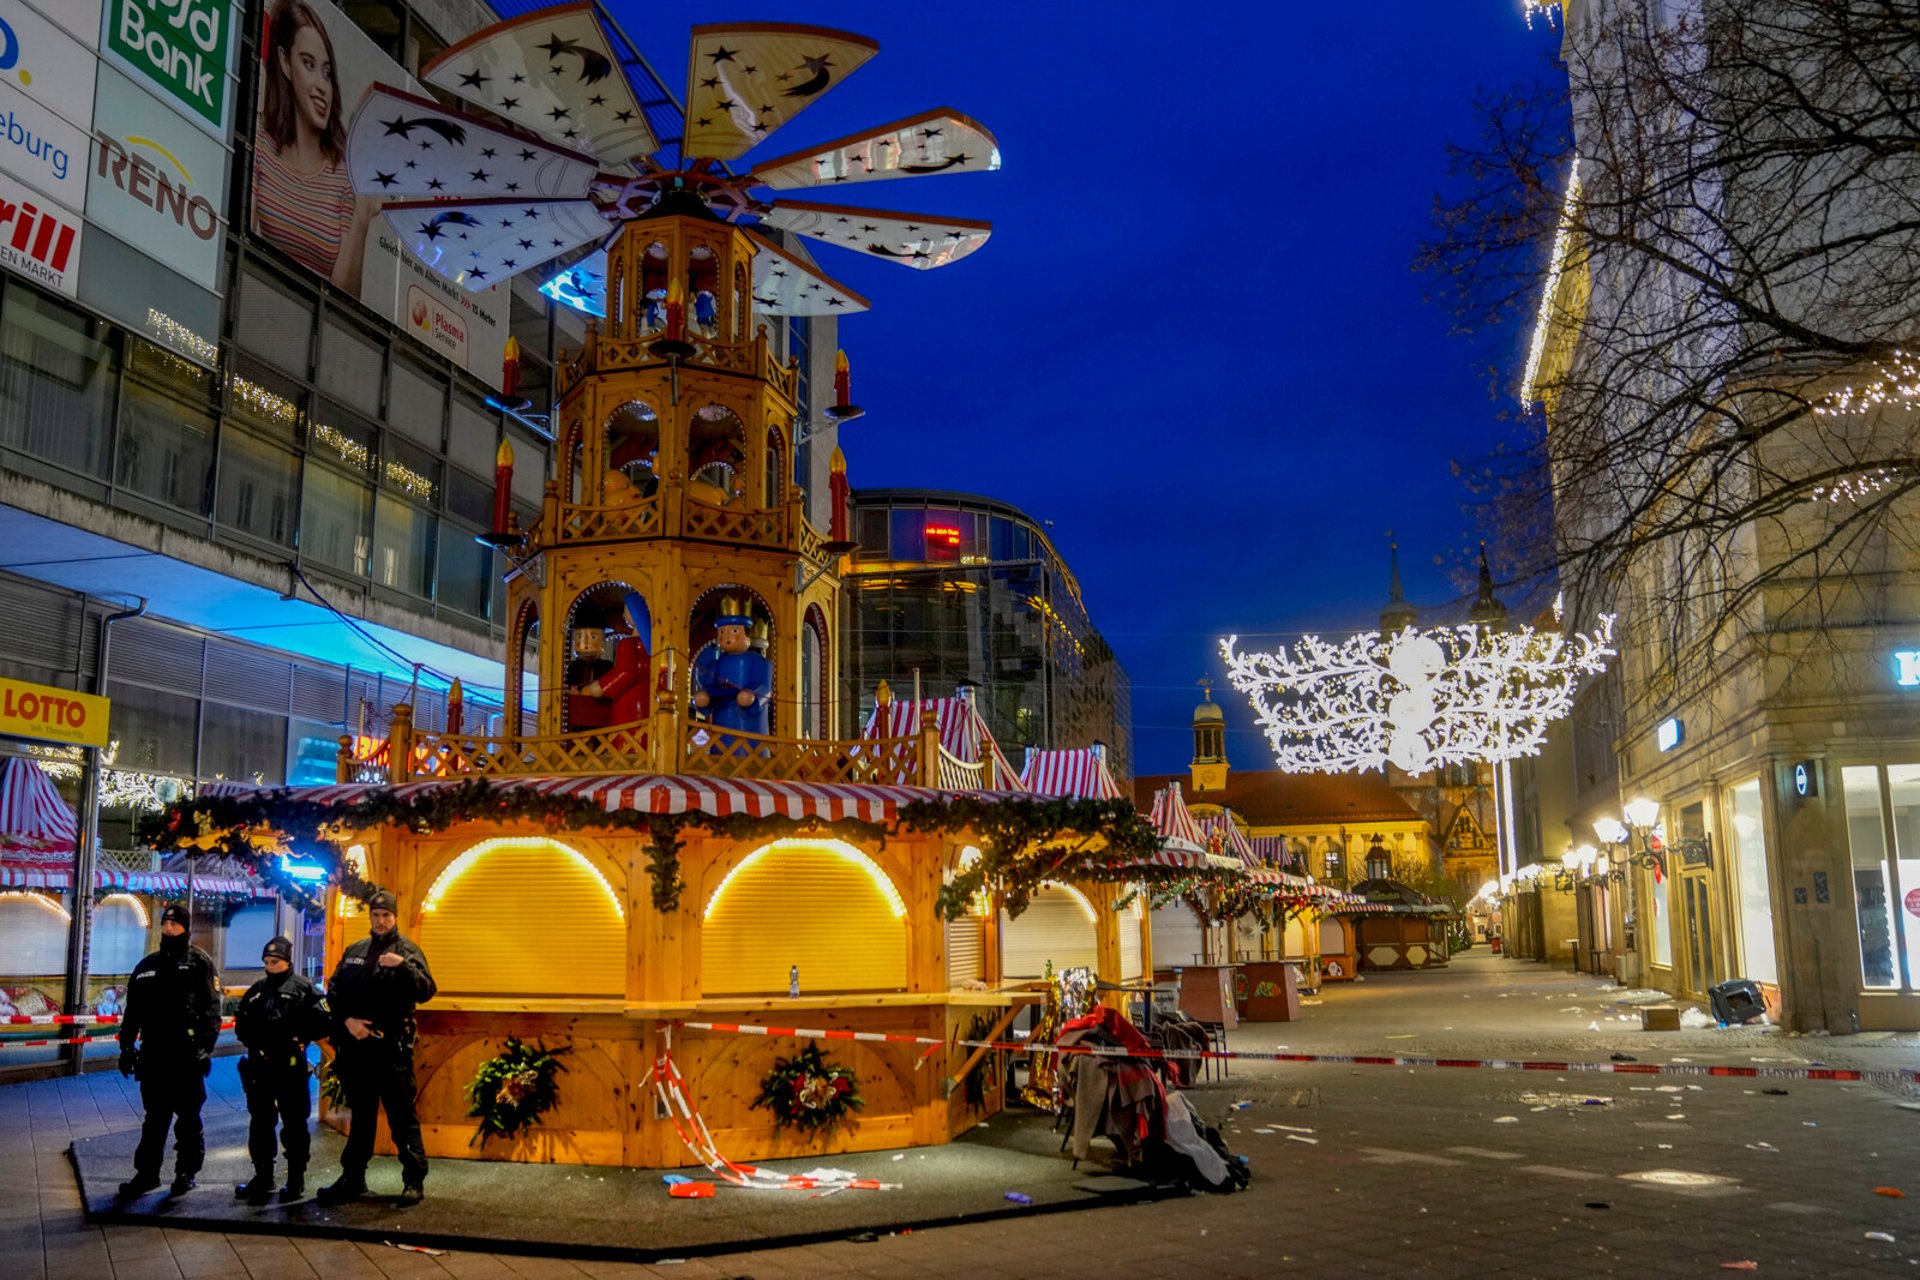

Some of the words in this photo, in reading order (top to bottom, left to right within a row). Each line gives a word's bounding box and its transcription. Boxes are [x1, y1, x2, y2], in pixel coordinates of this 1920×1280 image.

[119, 0, 214, 107] Bank
[96, 130, 217, 240] RENO
[21, 256, 63, 288] MARKT
[425, 270, 441, 289] Alten
[442, 281, 459, 301] Markt
[480, 309, 497, 328] Meter
[435, 312, 464, 343] Plasma
[435, 328, 457, 351] Service
[4, 689, 85, 728] LOTTO
